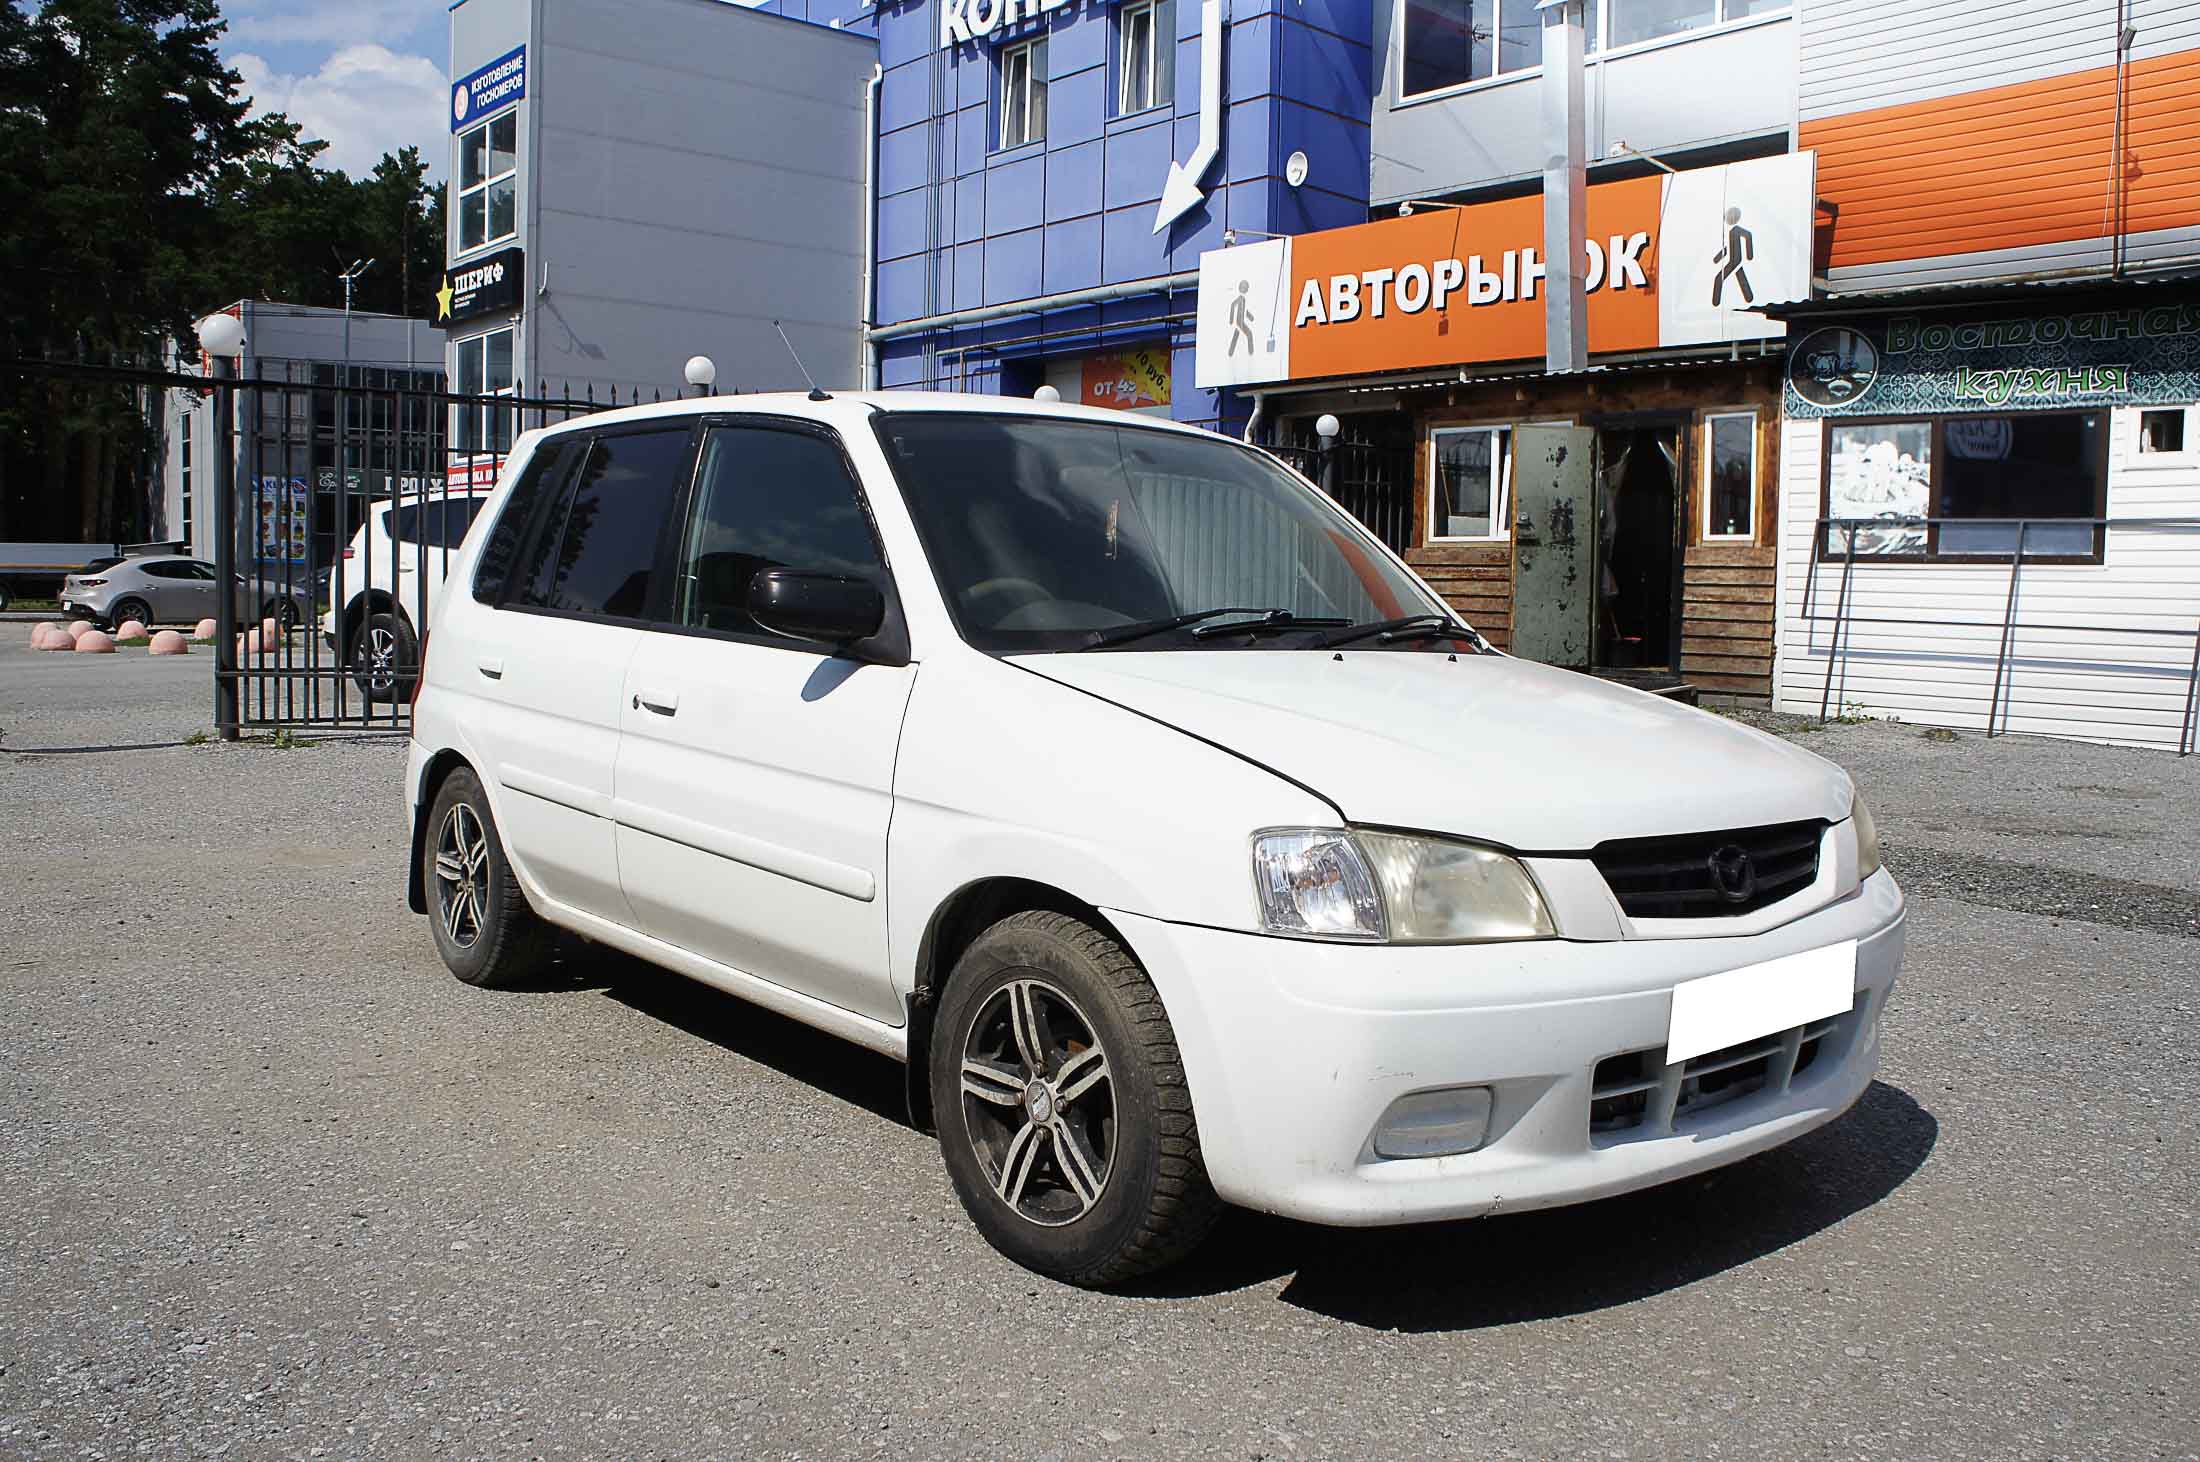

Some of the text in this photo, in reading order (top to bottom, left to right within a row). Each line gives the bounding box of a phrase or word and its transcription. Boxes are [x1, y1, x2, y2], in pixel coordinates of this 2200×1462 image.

[471, 54, 523, 95] ИЗГОТОВЛЕНИЕ
[477, 73, 523, 109] ГОСНОМЕРОВ
[454, 262, 504, 295] ШЕРИФ
[1955, 364, 2131, 406] кухня
[448, 467, 484, 487] АВТОМЙКА
